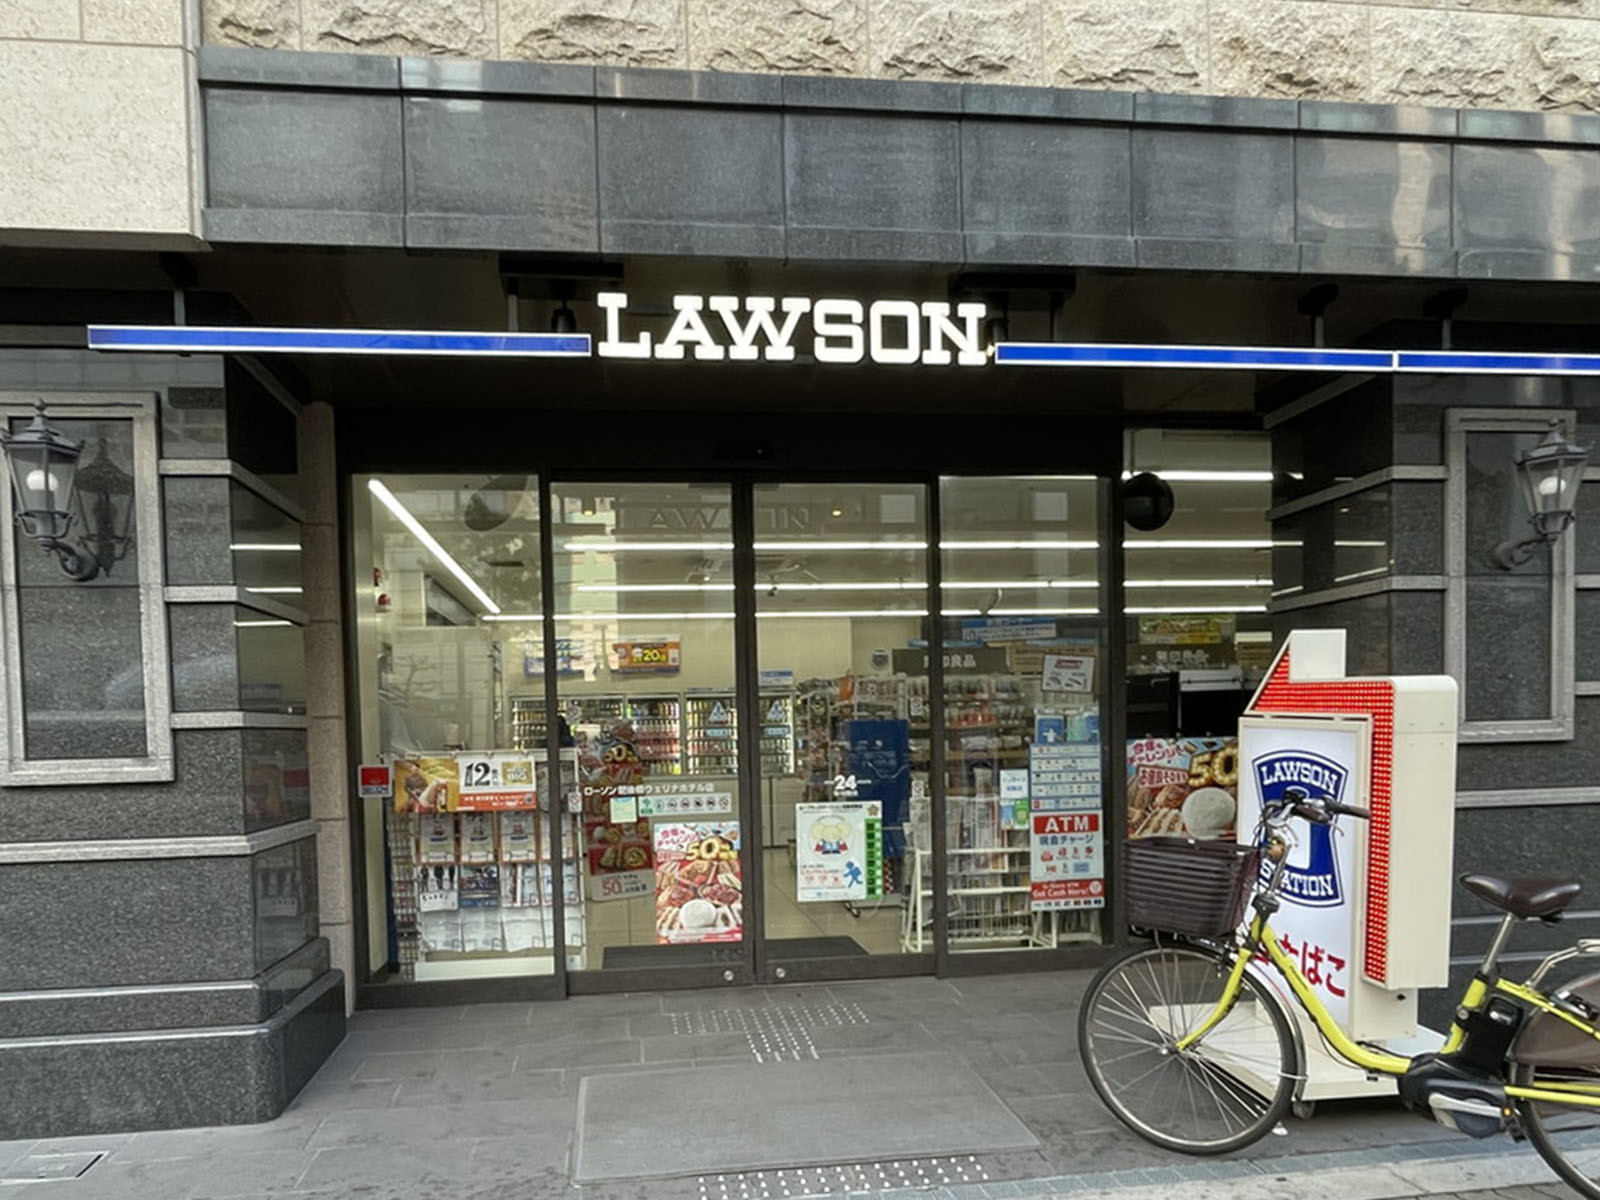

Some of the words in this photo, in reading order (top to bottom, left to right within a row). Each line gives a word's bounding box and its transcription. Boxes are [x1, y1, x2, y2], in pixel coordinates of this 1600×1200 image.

[597, 292, 987, 366] LAWSON
[834, 775, 857, 790] 24
[1260, 763, 1338, 794] LAWSON
[1044, 816, 1090, 834] ATM
[1259, 858, 1334, 896] SATION
